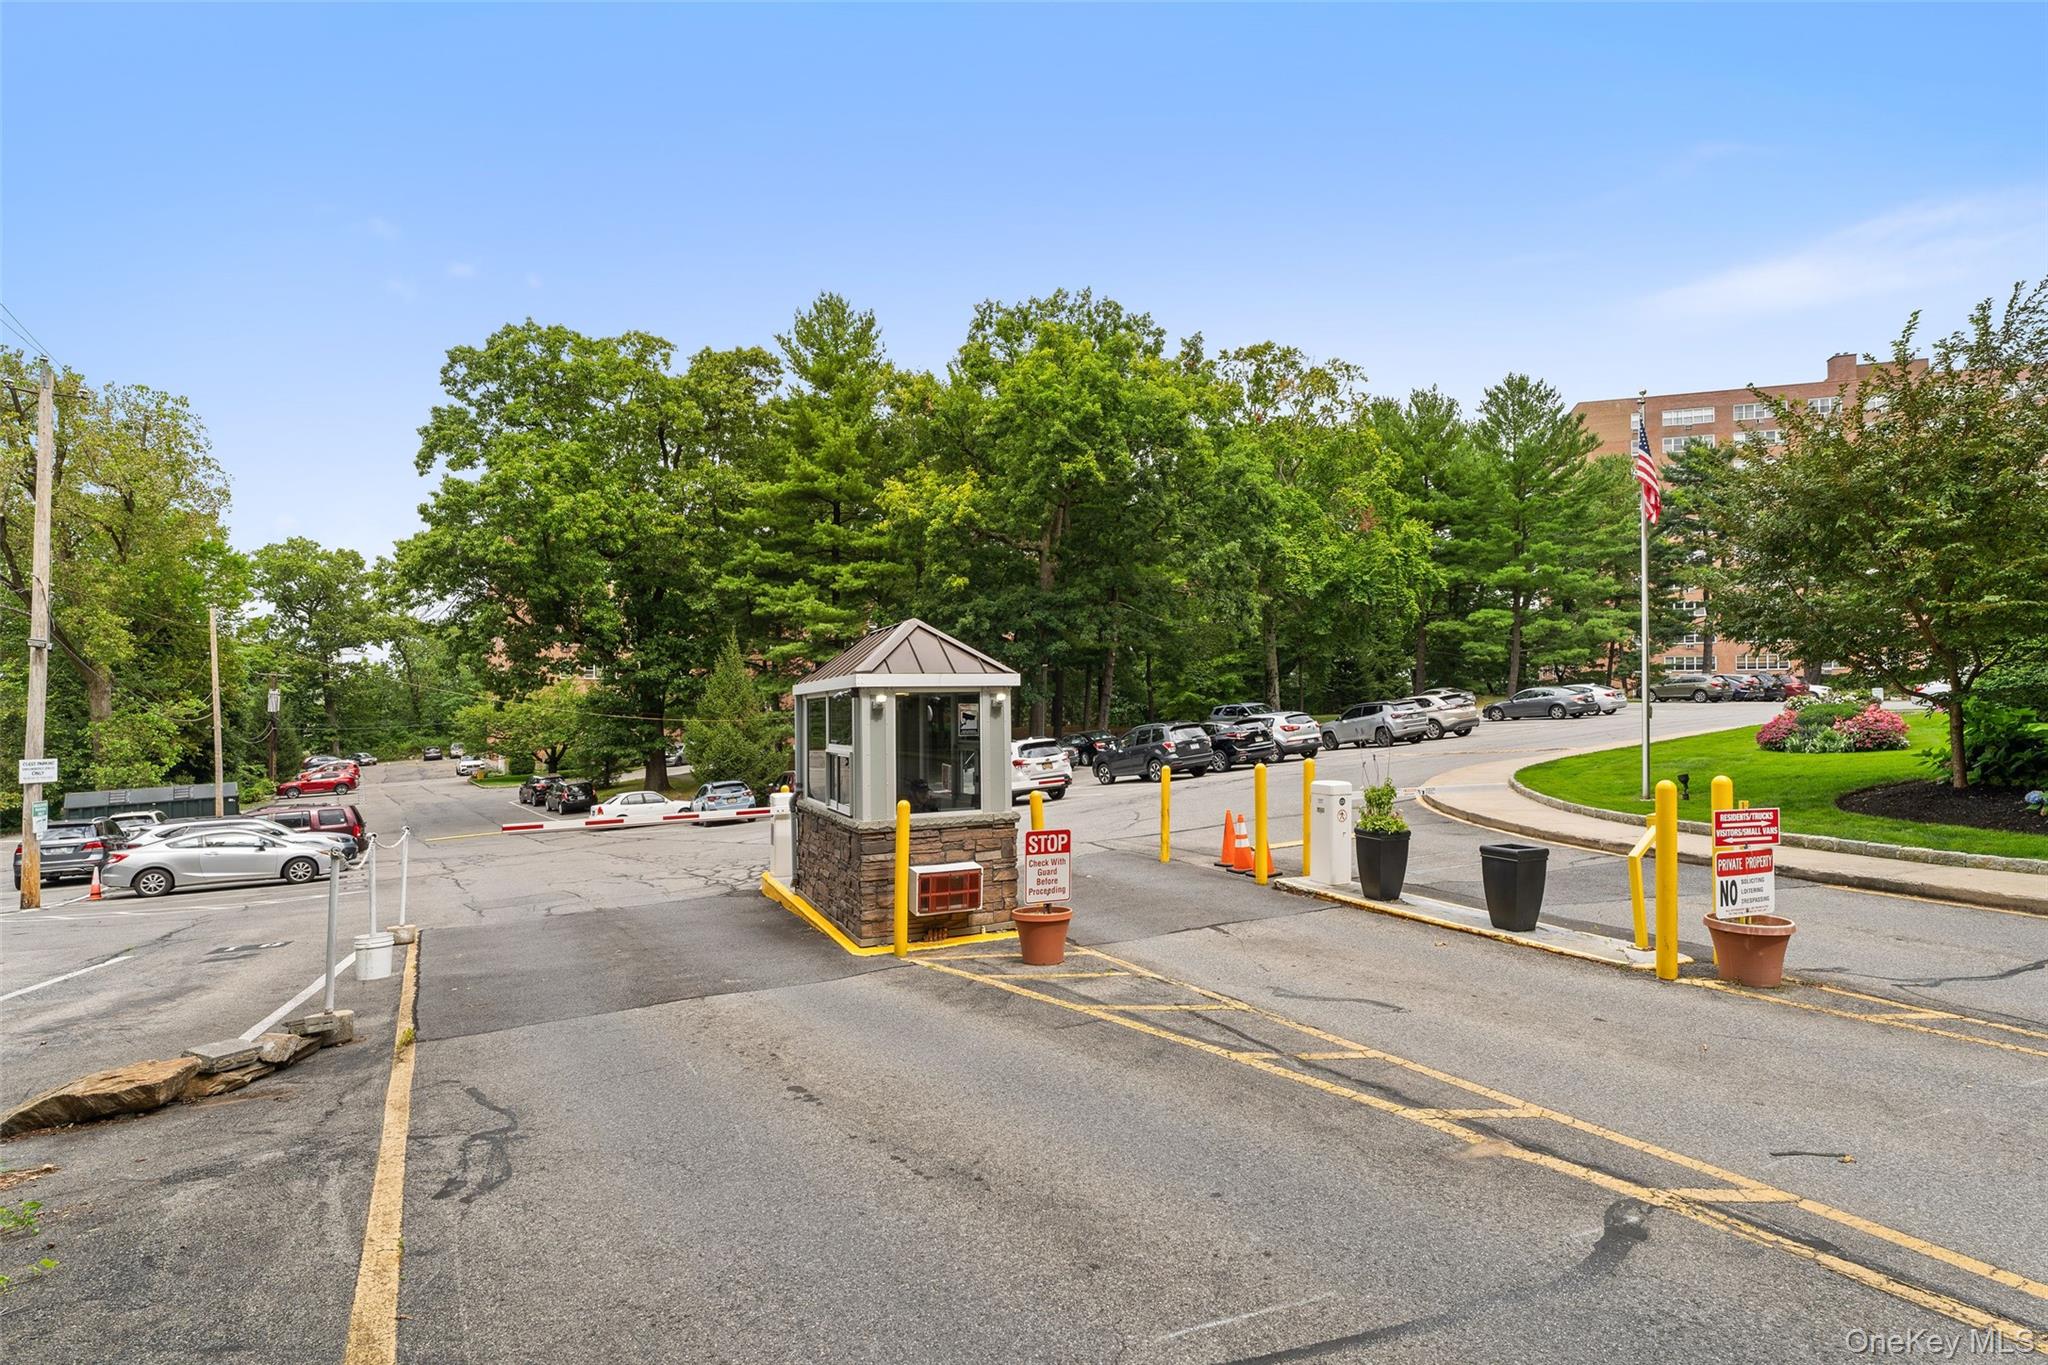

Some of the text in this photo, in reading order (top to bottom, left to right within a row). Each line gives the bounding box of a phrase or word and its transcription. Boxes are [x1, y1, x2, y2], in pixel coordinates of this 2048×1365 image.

[1719, 811, 1774, 822] RESIDENTS/TRUCKS
[1715, 826, 1778, 837] VISITORS/SMALL VANS
[1028, 833, 1068, 853] STOP
[1028, 857, 1067, 868] Check With
[1717, 854, 1774, 872] PRIVATE PROPERTY
[1037, 868, 1058, 877] Guard
[1036, 877, 1059, 886] Before
[1740, 876, 1765, 885] SOLICITING
[1028, 886, 1067, 896] Proceeding
[1720, 879, 1738, 907] NO
[1740, 887, 1764, 895] LOITERING
[1741, 895, 1770, 905] TRESPASSING
